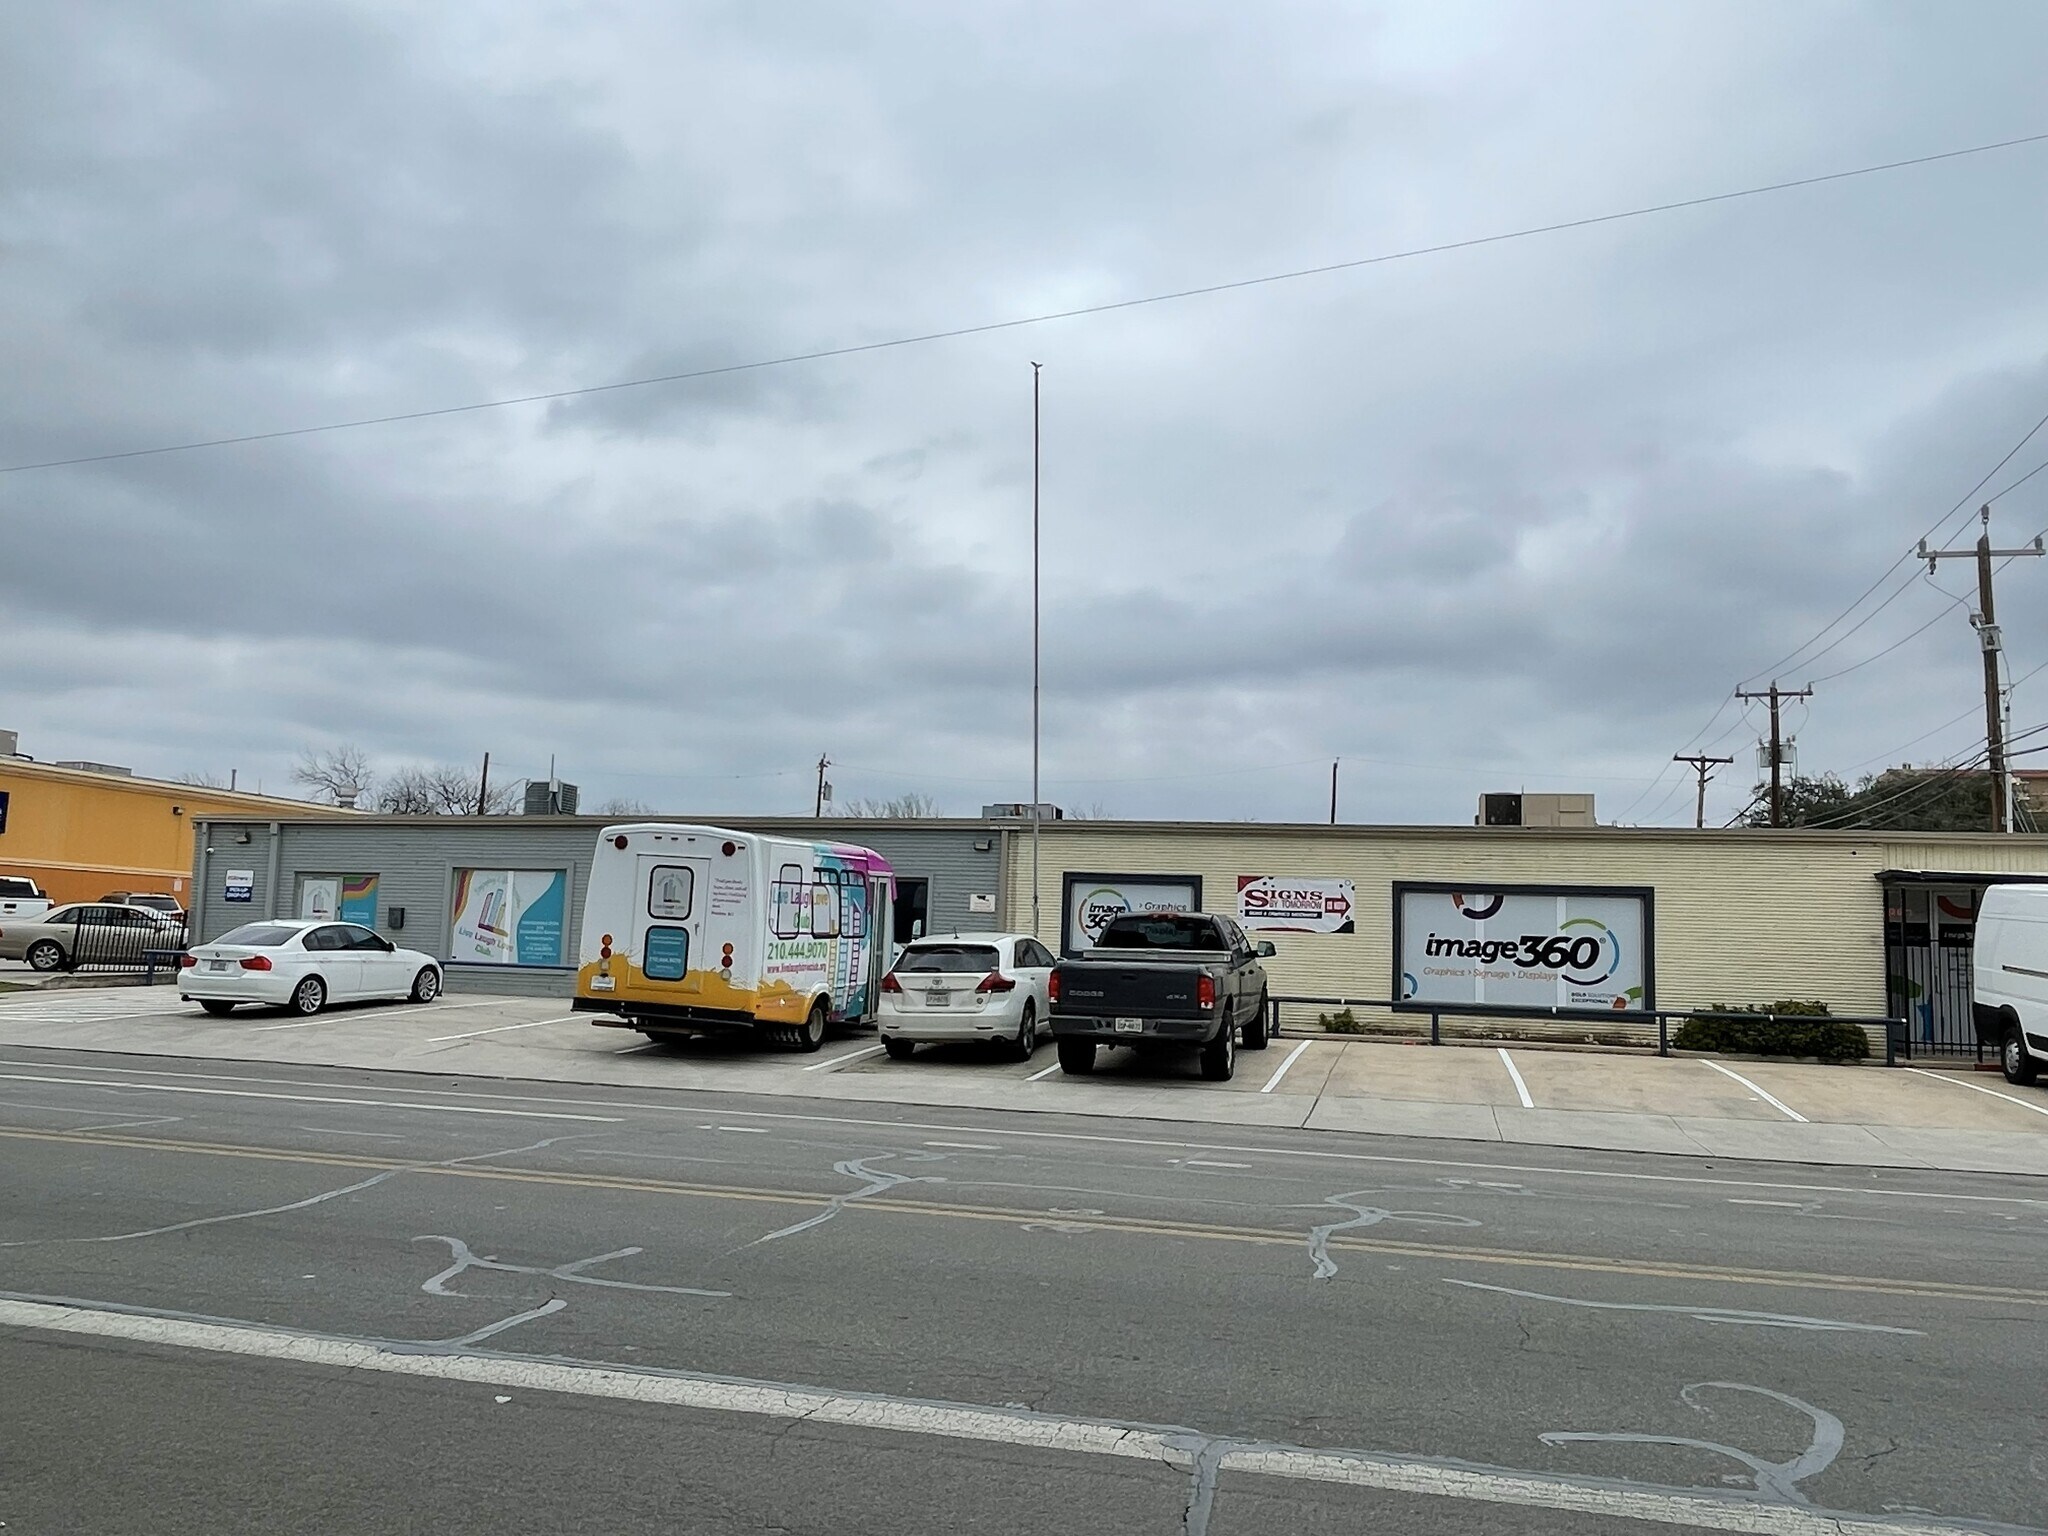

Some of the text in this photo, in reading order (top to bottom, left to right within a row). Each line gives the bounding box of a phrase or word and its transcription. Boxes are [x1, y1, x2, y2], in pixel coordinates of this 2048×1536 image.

[1144, 901, 1188, 912] Graphics
[1245, 889, 1323, 908] SIGNS
[1269, 900, 1279, 908] BY
[1282, 900, 1322, 909] TOMORROW
[1089, 902, 1127, 914] image
[1085, 913, 1113, 930] 36
[767, 942, 828, 960] 210.444.9070
[1425, 932, 1601, 970] image360
[1423, 966, 1559, 981] Graphics Signage Displays
